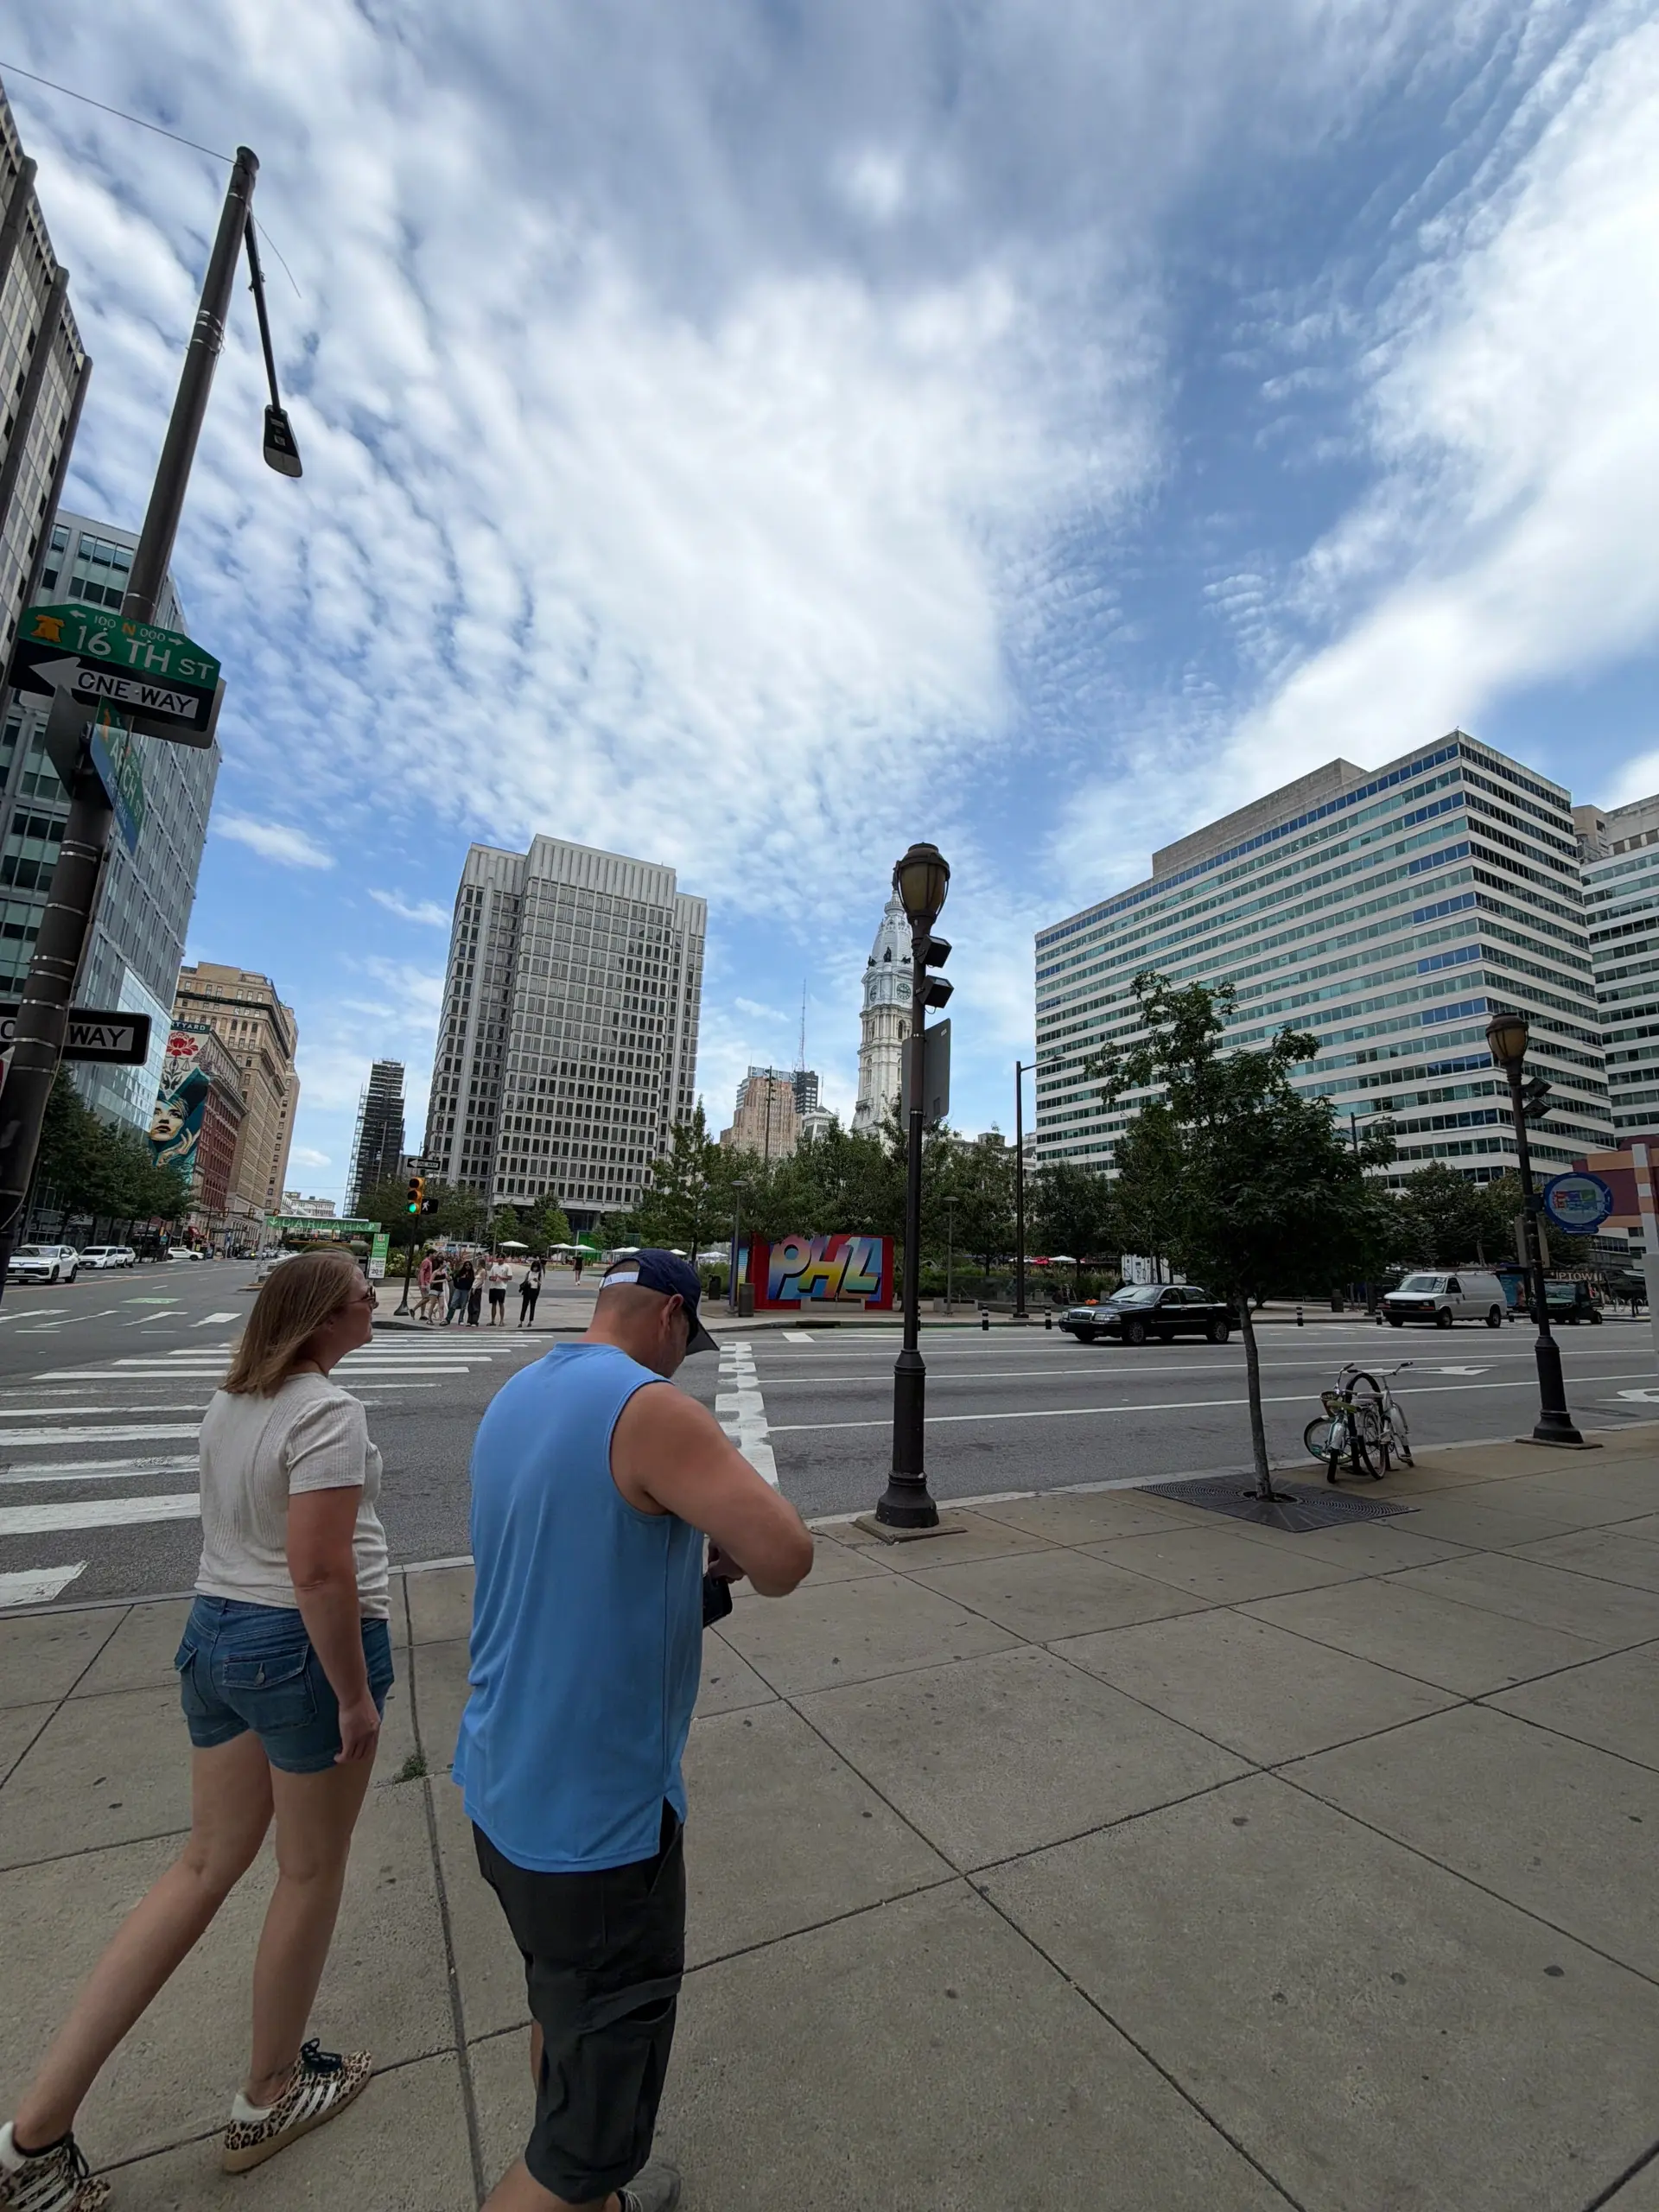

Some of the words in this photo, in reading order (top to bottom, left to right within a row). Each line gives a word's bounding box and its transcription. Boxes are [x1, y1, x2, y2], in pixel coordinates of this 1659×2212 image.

[94, 615, 117, 629] 100
[121, 622, 137, 637] N
[140, 628, 166, 642] 000
[77, 626, 112, 656] 16
[126, 638, 171, 673] TH
[178, 658, 214, 680] ST
[78, 671, 130, 699] ONE
[140, 686, 193, 714] WAY
[69, 1025, 126, 1047] WAY
[768, 1234, 880, 1299] PHL
